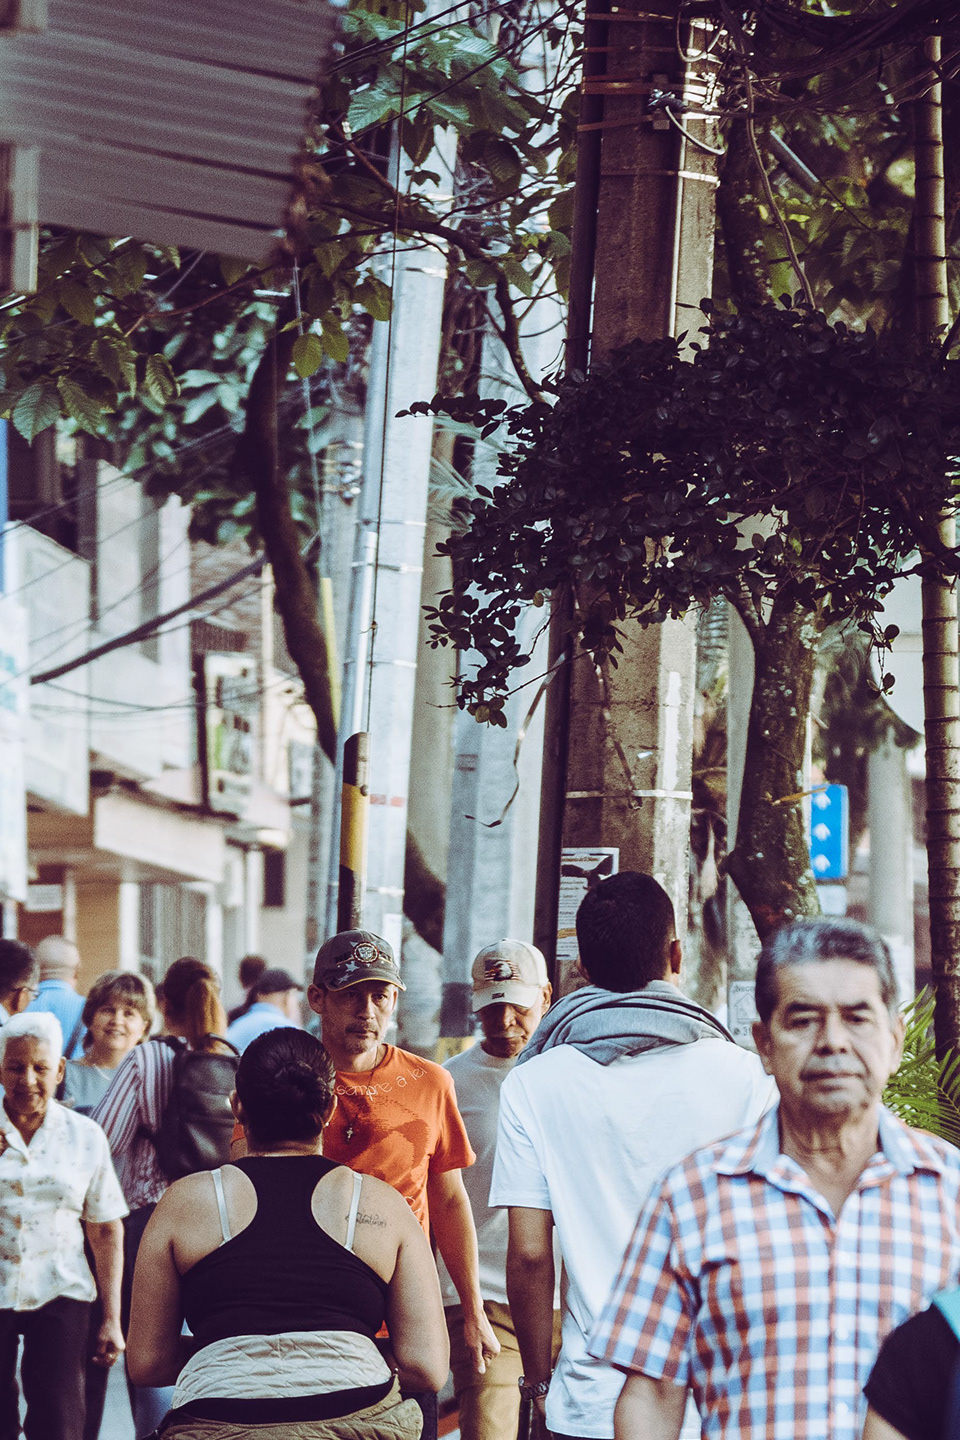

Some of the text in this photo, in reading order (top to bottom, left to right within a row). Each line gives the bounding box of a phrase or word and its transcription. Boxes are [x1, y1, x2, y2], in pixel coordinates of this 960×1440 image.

[336, 1065, 428, 1101] sempre a lei
